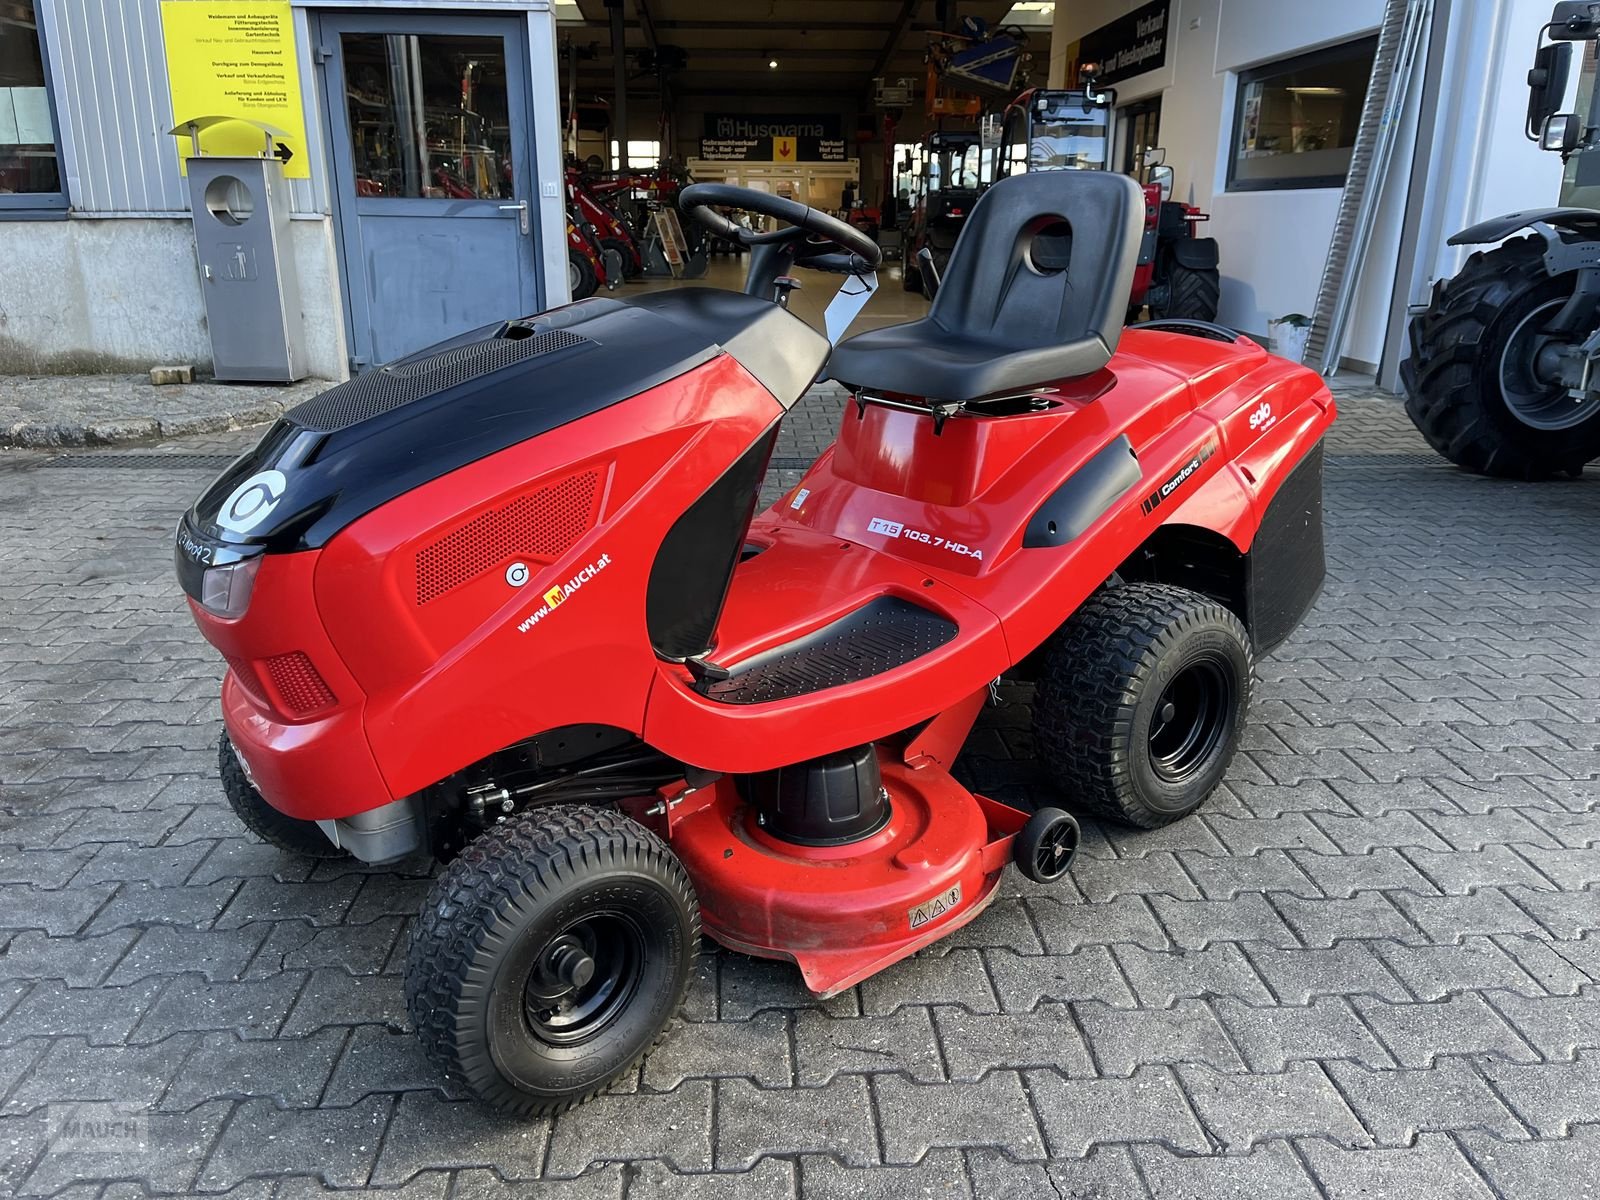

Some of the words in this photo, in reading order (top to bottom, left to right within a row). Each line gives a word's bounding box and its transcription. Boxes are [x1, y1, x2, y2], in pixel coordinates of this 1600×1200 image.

[1136, 8, 1165, 38] Verkauf
[1118, 36, 1162, 69] Teleskoplader
[736, 121, 824, 137] Husqvarna
[1161, 459, 1199, 496] Comfort
[872, 521, 881, 530] T
[882, 523, 899, 534] 15
[903, 529, 944, 546] 103.7
[944, 540, 983, 560] HD-A
[517, 553, 612, 633] www.MAUCH.at
